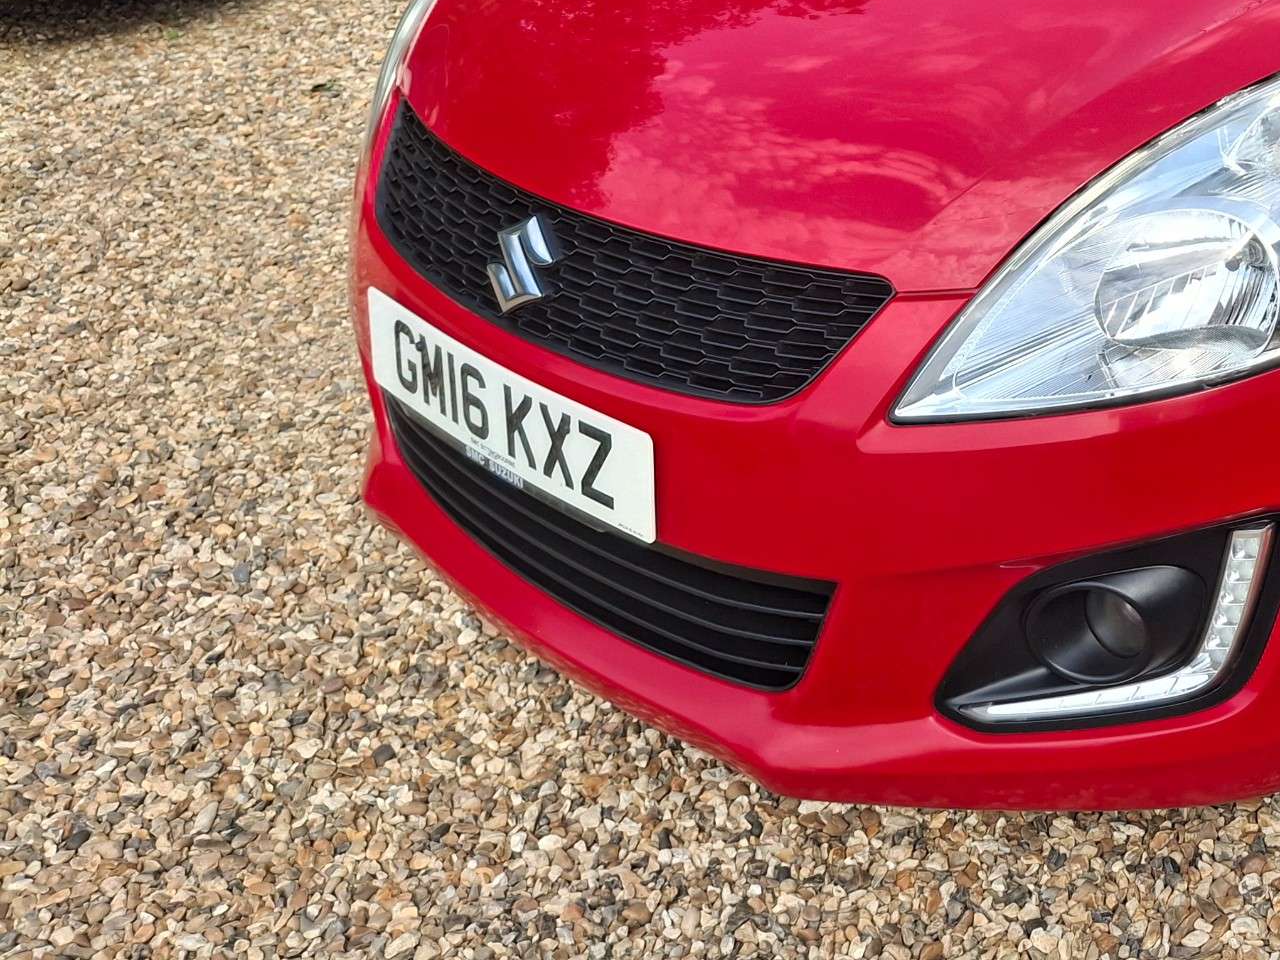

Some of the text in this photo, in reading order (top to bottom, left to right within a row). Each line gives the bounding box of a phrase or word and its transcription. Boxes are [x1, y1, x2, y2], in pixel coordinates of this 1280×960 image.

[394, 319, 615, 511] GM16 KXZ
[488, 459, 524, 489] SUZUKI
